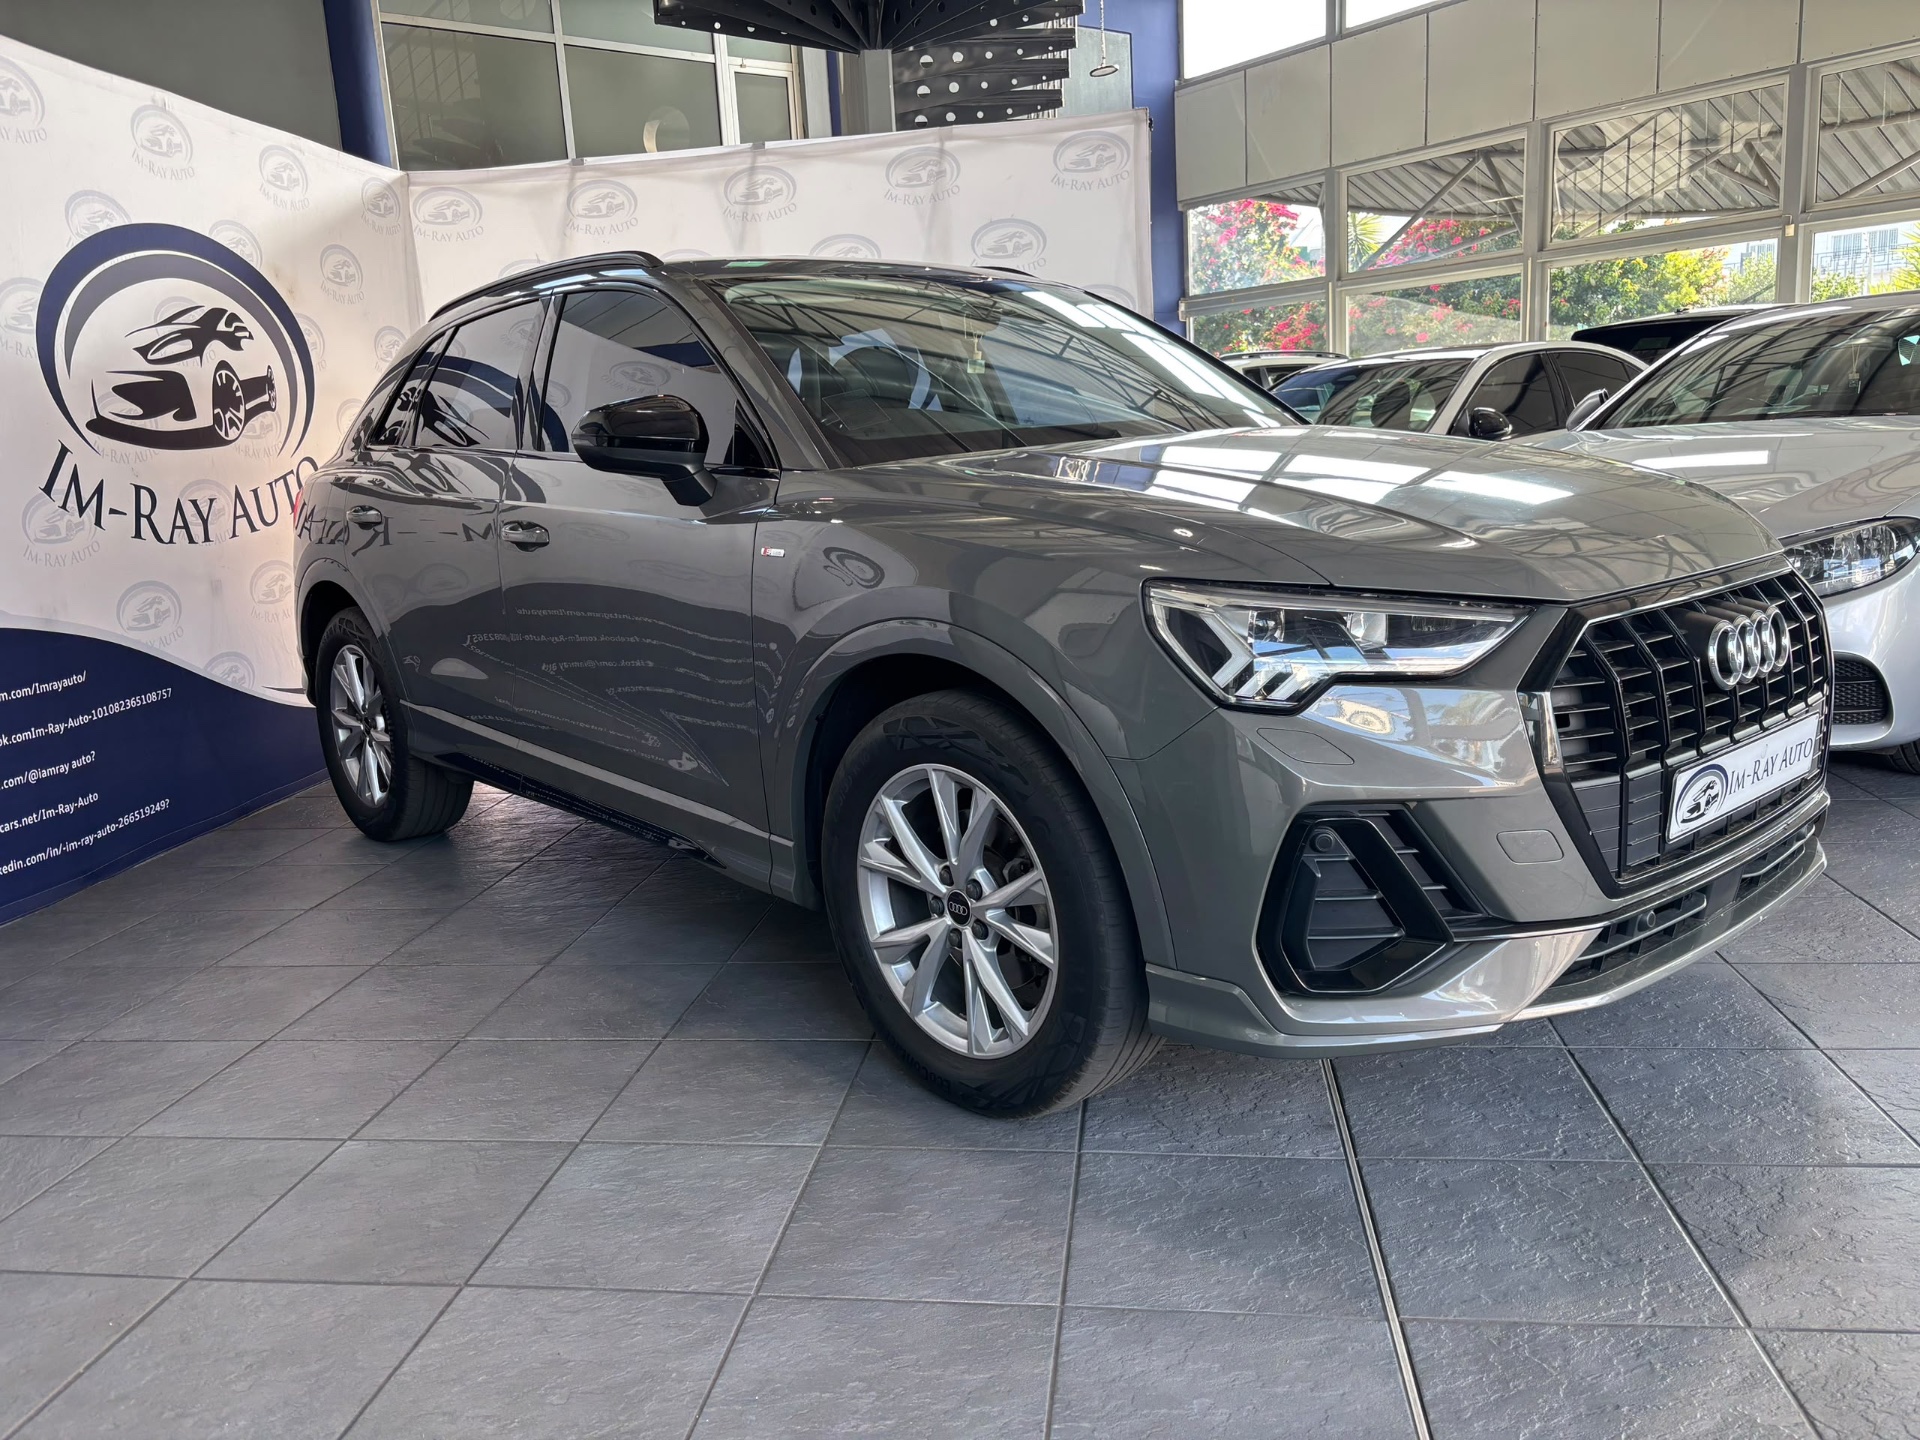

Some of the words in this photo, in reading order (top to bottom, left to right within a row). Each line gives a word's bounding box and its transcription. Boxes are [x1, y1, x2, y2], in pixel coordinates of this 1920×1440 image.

[15, 127, 48, 145] AUTO
[131, 148, 167, 179] IM-RAY
[170, 166, 195, 181] AUTO
[1050, 173, 1094, 191] IM-RAY
[1097, 170, 1130, 189] AUTO
[259, 183, 288, 211] IM-RAY
[290, 197, 310, 212] AUTO
[884, 188, 925, 206] IM-RAY
[929, 184, 960, 204] AUTO
[361, 210, 384, 235] IM-RAY
[722, 206, 763, 223] IM-RAY
[766, 202, 797, 221] AUTO
[413, 224, 452, 242] IM-RAY
[455, 225, 484, 241] AUTO
[566, 218, 606, 236] IM-RAY
[609, 216, 639, 235] AUTO
[320, 280, 346, 305] IM-RAY
[347, 290, 365, 305] AUTO
[38, 439, 217, 545] IM-RAY
[22, 544, 69, 569] IM-RAY
[71, 540, 101, 565] AUTO
[250, 605, 280, 623] IM-RAY
[158, 625, 184, 649] AUTO
[0, 761, 71, 791] .com/@iamray
[71, 751, 96, 770] auto?
[1728, 753, 1780, 796] IM-RAY
[1778, 737, 1814, 772] AUTO
